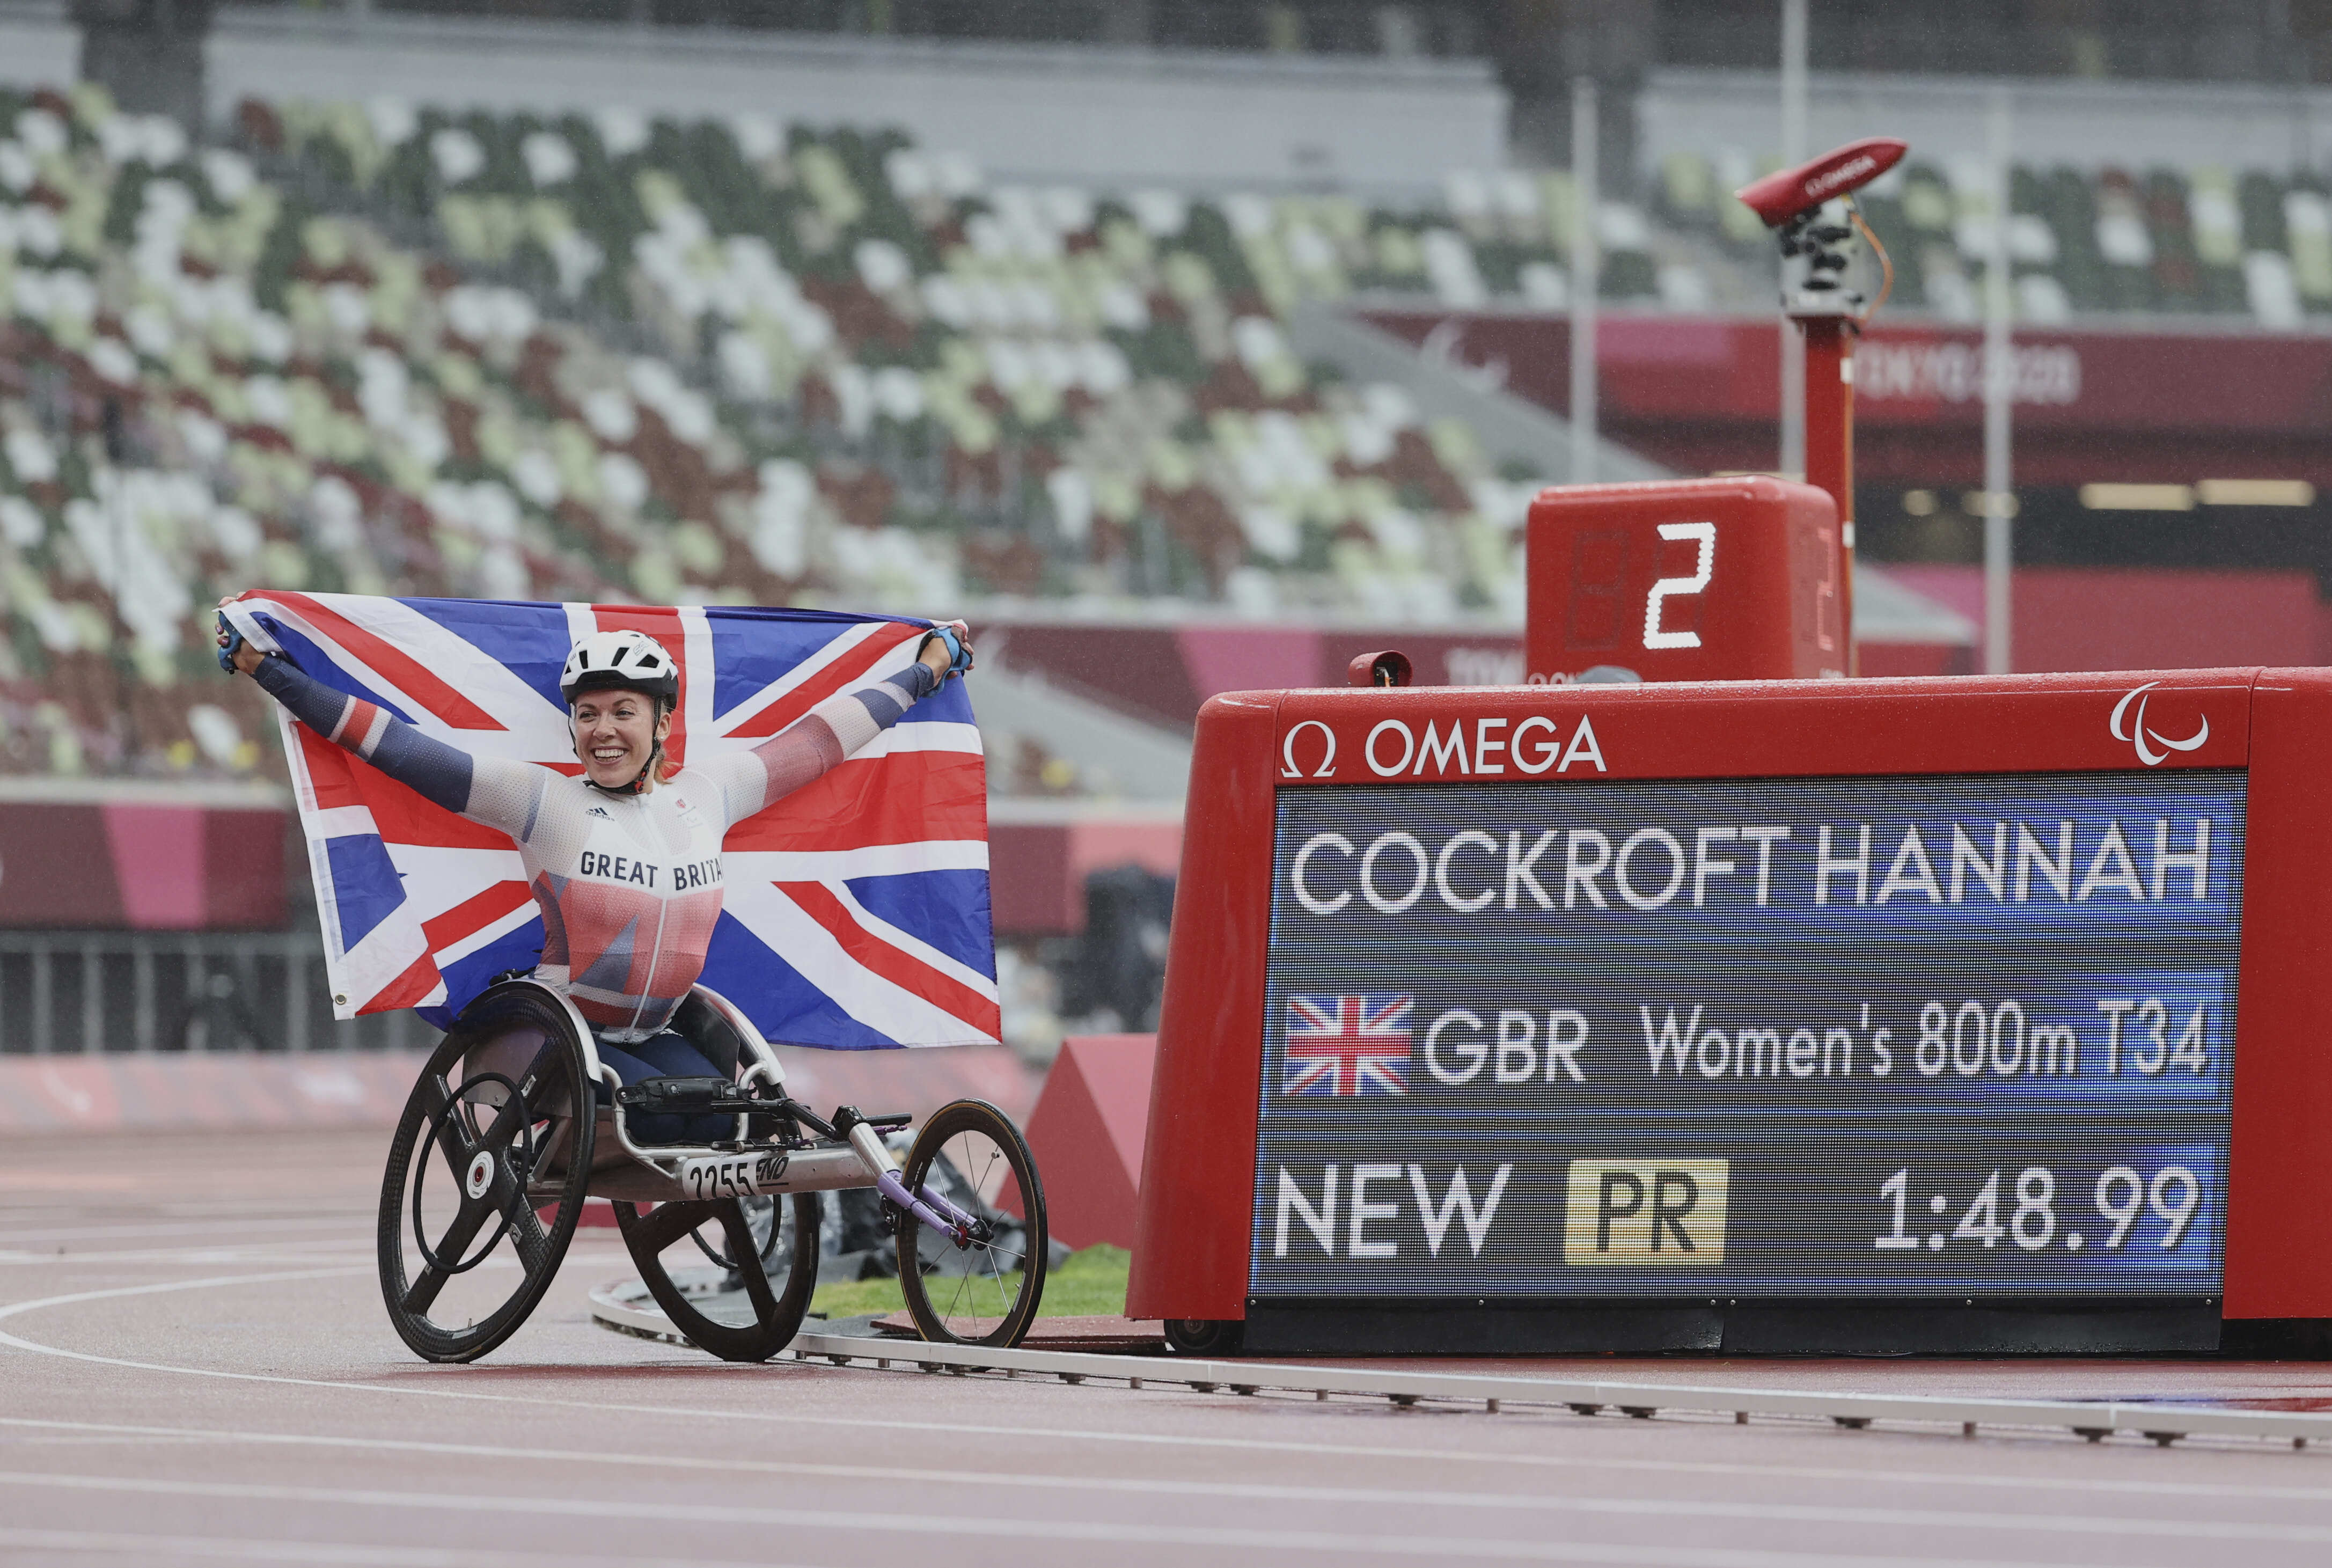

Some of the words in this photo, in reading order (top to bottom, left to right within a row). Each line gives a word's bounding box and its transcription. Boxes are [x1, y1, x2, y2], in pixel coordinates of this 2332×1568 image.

[1643, 522, 1716, 649] 2
[1365, 713, 1607, 778] OMEGA
[585, 810, 615, 822] adidas
[581, 851, 658, 888] GREAT
[1290, 825, 1791, 914] COCKROFT
[1815, 818, 2211, 906] HANNAH
[1424, 1007, 1590, 1086] GBR
[1640, 1002, 1894, 1078] Women's
[1915, 1000, 2079, 1076] 800m
[2097, 999, 2210, 1076] T34
[690, 1162, 758, 1200] 2255
[1274, 1162, 1513, 1258] NEW
[1596, 1171, 1700, 1253] PR
[1874, 1166, 2200, 1252] 1:48.99
